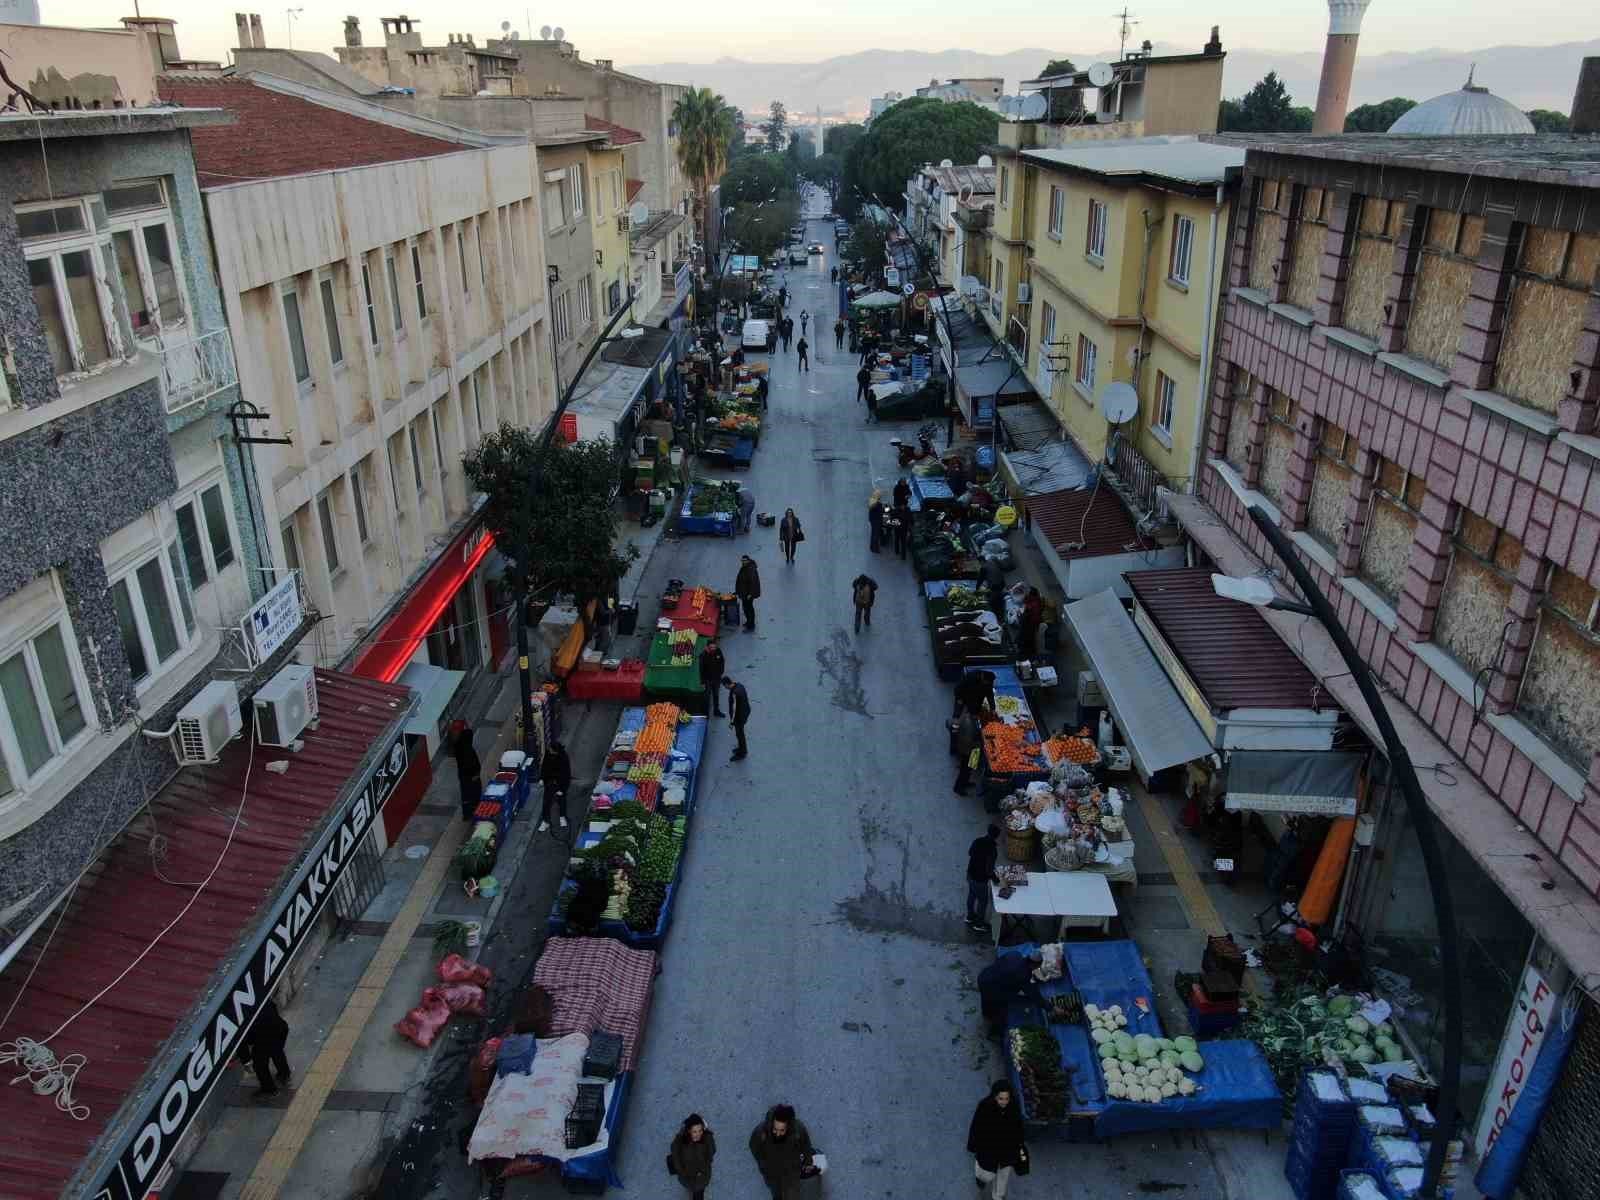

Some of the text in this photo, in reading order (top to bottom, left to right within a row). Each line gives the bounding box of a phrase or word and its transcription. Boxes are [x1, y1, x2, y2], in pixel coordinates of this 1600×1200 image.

[133, 788, 371, 1183] DOĞAN AYAKKABI
[1482, 980, 1549, 1162] FOTOKOP
